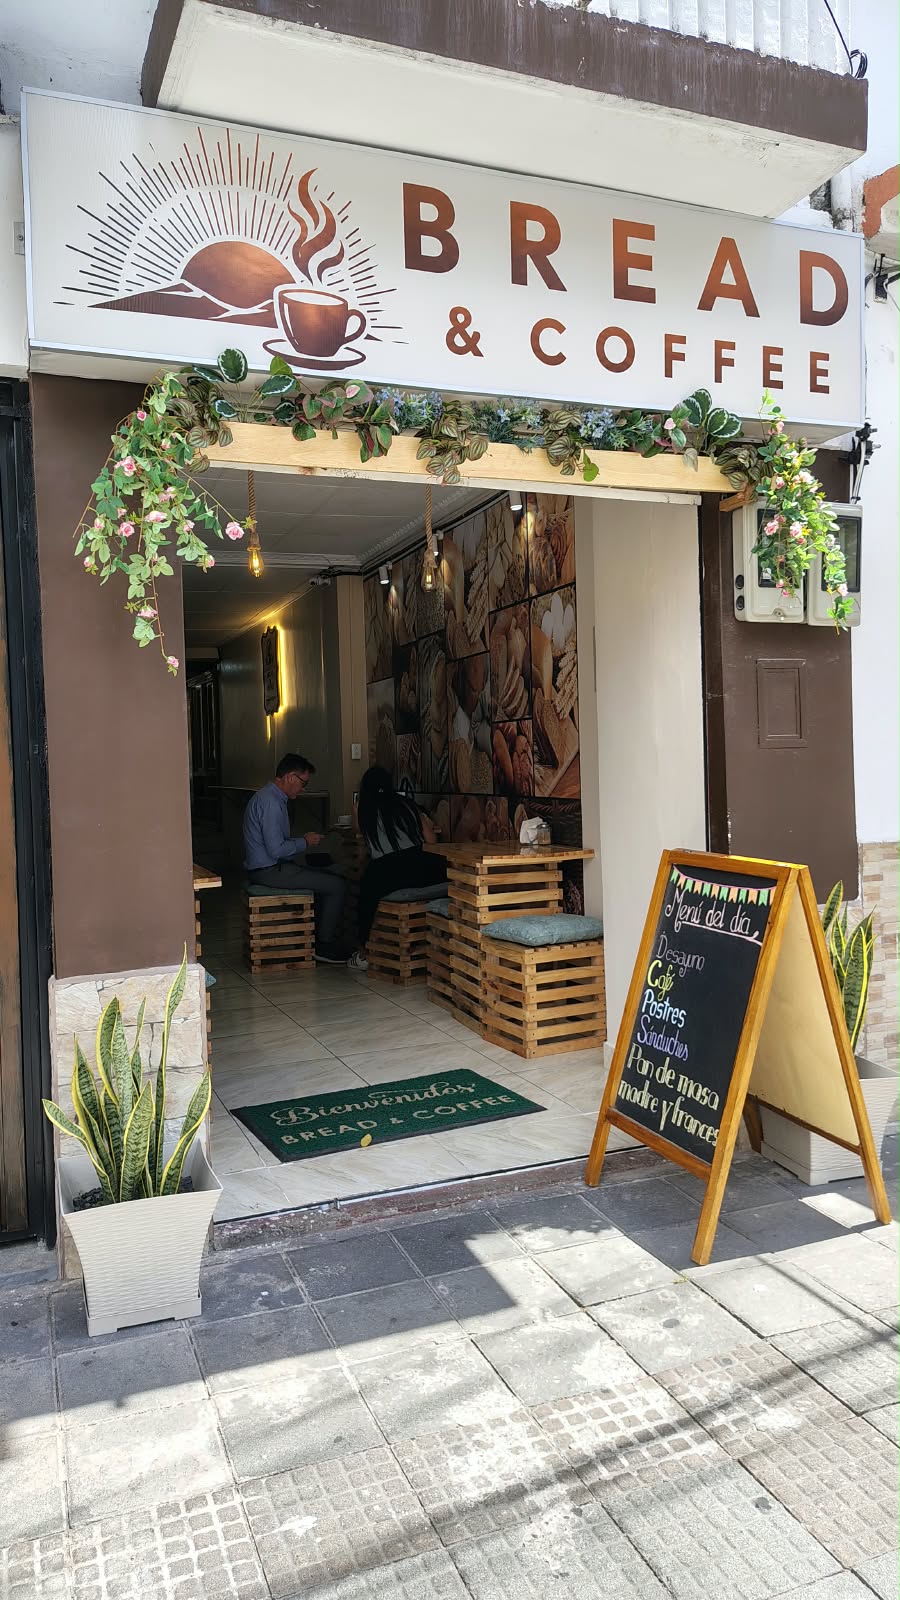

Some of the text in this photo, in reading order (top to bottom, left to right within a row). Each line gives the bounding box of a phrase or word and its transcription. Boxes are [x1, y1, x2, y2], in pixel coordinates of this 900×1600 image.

[402, 182, 848, 327] BREAD
[445, 306, 830, 394] & COFFEE
[665, 888, 751, 934] Menú del día
[656, 934, 705, 977] Desayuno
[647, 960, 676, 1001] Café
[642, 989, 687, 1028] Postres
[637, 1014, 688, 1061] Sánduches
[626, 1042, 720, 1110] Pan de masa
[270, 1082, 476, 1126] Bienvenidos
[280, 1095, 515, 1145] BREAD & COFFEE
[617, 1080, 720, 1146] madre y frances
